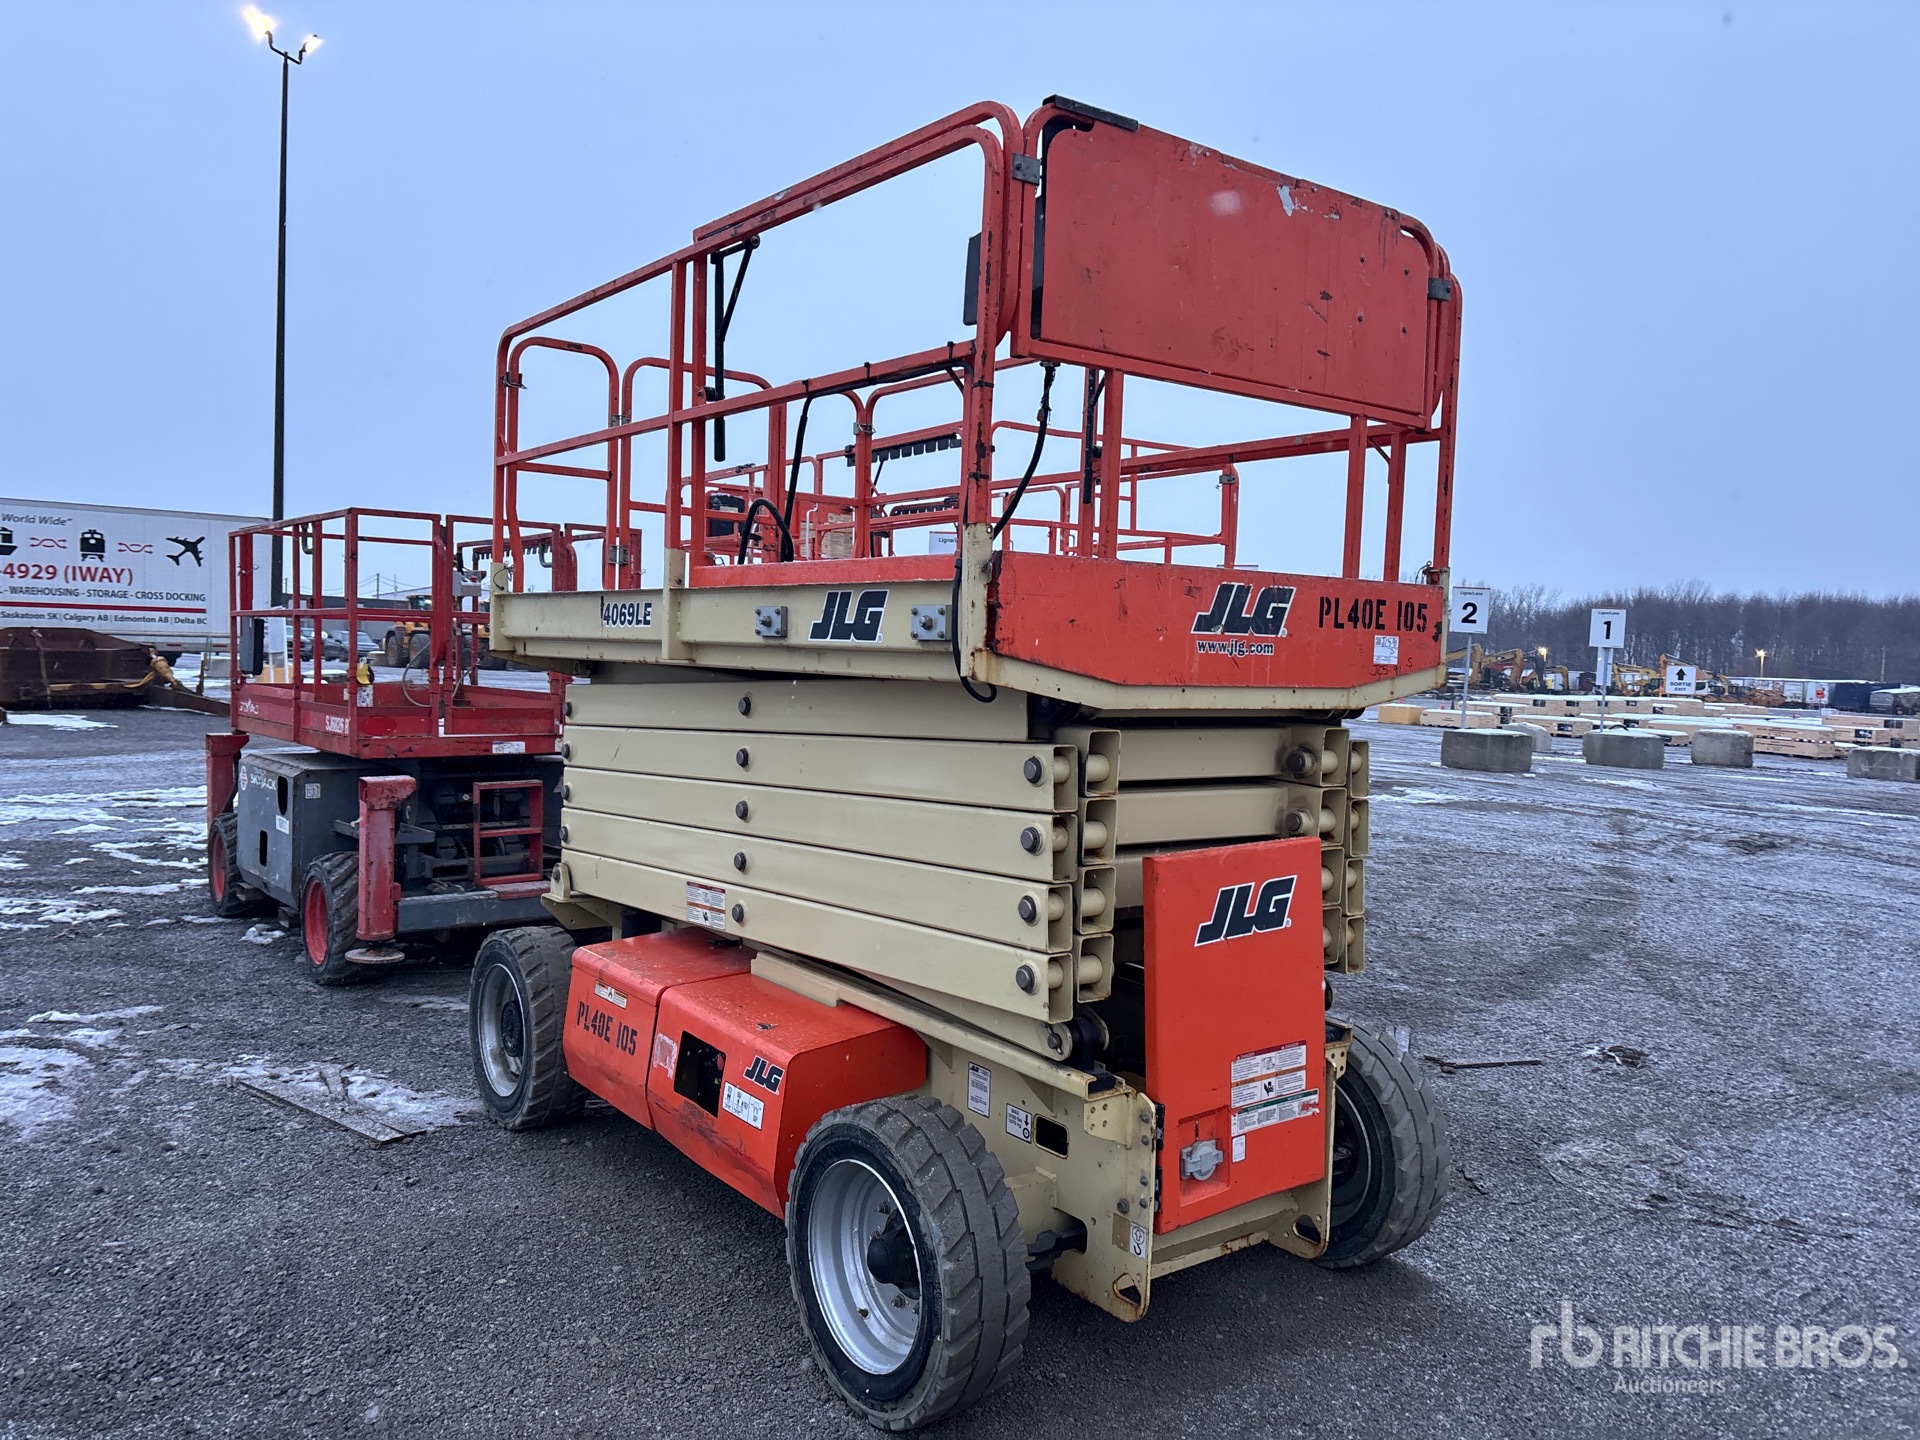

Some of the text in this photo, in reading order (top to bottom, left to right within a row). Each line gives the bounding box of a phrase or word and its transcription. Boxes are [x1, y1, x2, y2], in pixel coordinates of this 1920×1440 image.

[1, 513, 36, 523] World
[0, 563, 133, 586] 4929 (IWAY)
[9, 586, 79, 596] WAREHOUSING
[87, 589, 128, 599] STORAGE
[135, 591, 164, 600] CROSS
[166, 592, 205, 601] DOCKING
[0, 611, 45, 620] Saskatoon
[63, 613, 95, 622] Calgary
[114, 615, 155, 623] Edmonton
[603, 602, 652, 627] 4069LE
[809, 590, 889, 642] JLG
[1191, 582, 1296, 636] JLG
[1319, 596, 1386, 630] PL40E
[1461, 602, 1478, 624] 2
[1603, 620, 1612, 640] 1
[1196, 639, 1274, 656] www.jlg.com
[1194, 875, 1297, 947] JLG
[577, 1001, 613, 1043] PL40E
[743, 1055, 785, 1094] JLG
